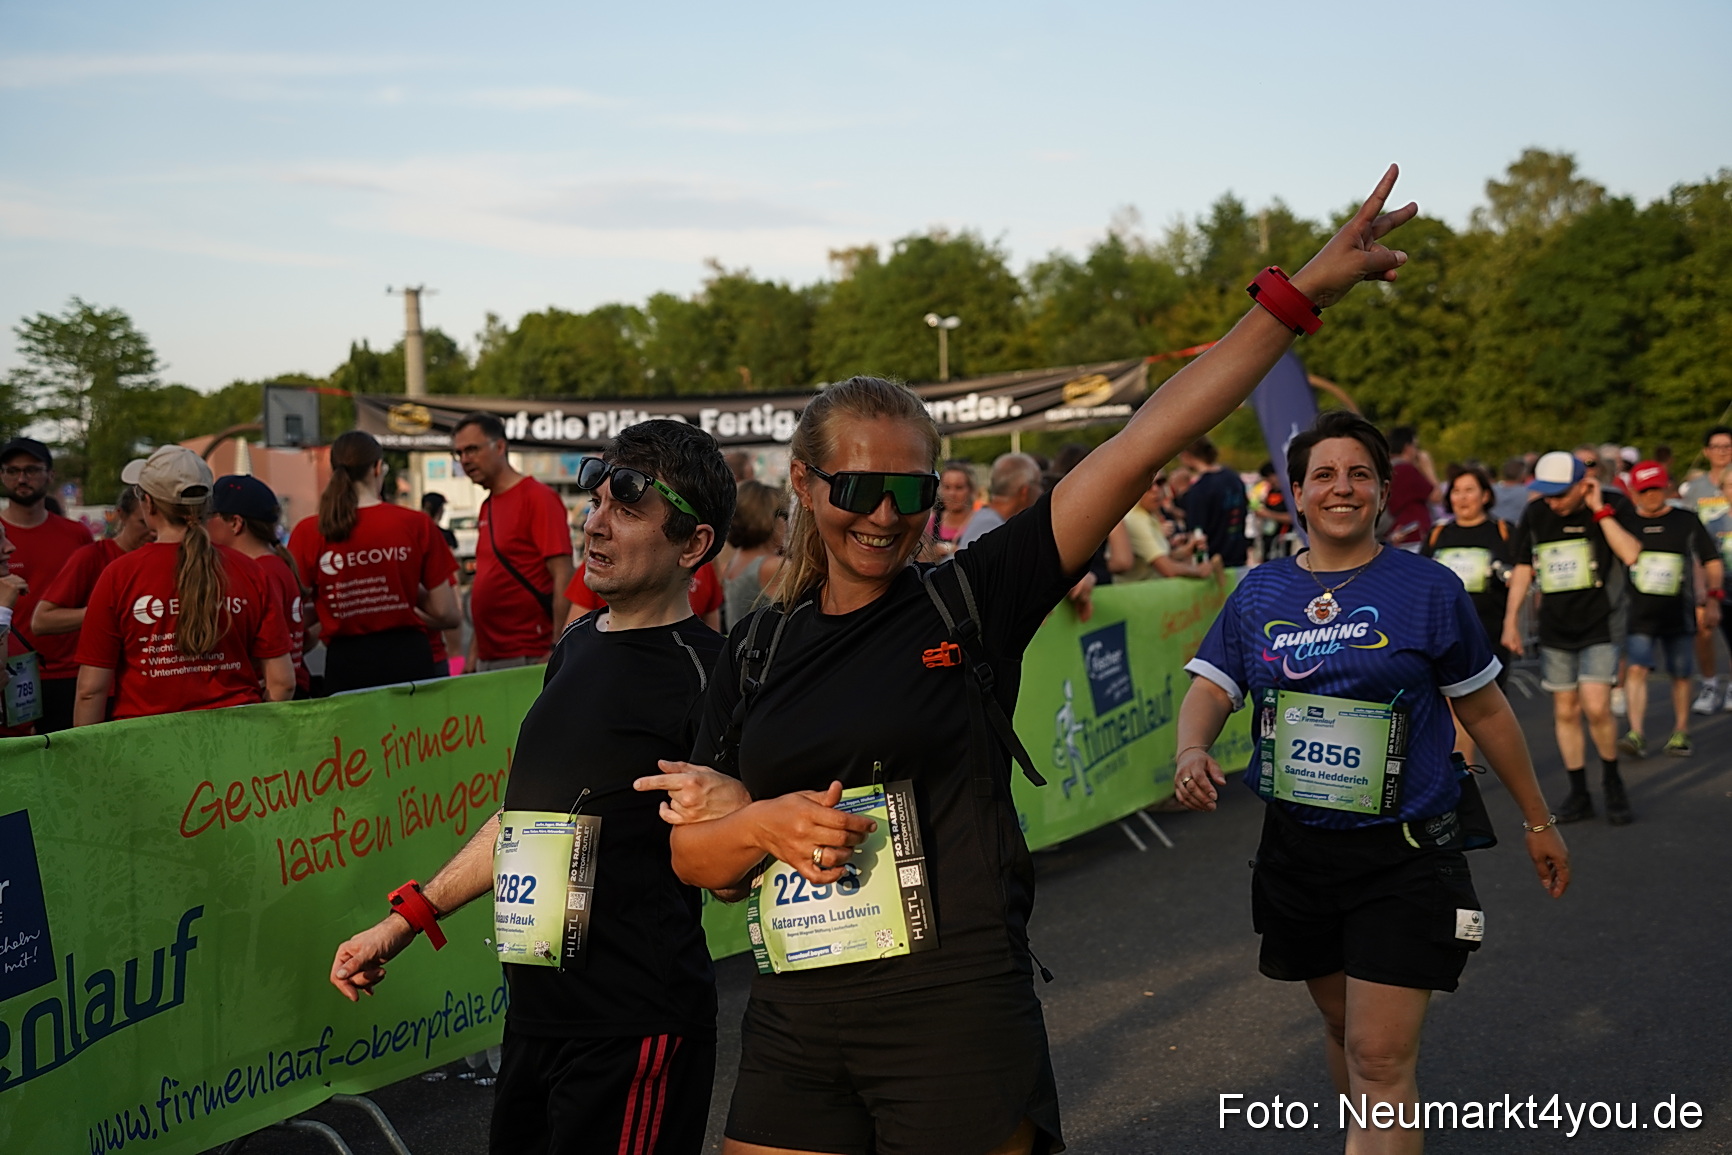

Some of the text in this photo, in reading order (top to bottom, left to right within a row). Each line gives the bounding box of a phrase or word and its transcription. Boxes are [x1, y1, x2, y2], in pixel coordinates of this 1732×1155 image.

[500, 410, 530, 440] uf
[531, 409, 585, 440] die
[346, 546, 408, 567] ECOVIS
[1294, 639, 1346, 660] Club
[16, 680, 35, 698] 789
[1291, 738, 1362, 769] 2856
[179, 714, 488, 838] Gesunde Firmen
[1284, 764, 1316, 779] Sandra
[1317, 770, 1369, 786] Hedderich
[896, 792, 906, 821] OUTLET
[1384, 777, 1395, 809] HILTL
[887, 793, 903, 858] 20 % RABATT
[901, 823, 911, 856] FACTORY
[276, 806, 393, 886] laufen
[570, 823, 583, 882] 20 % RABATT
[578, 825, 590, 883] FACTORY OUTLET
[495, 873, 538, 905] 2282
[509, 912, 536, 927] Hauk
[771, 903, 881, 931] Katarzyna Ludwin
[907, 890, 924, 941] HILTL
[566, 914, 579, 958] HILTL
[0, 904, 205, 1092] nlauf
[88, 973, 511, 1155] www.firmenlauf-oberpfalz.d
